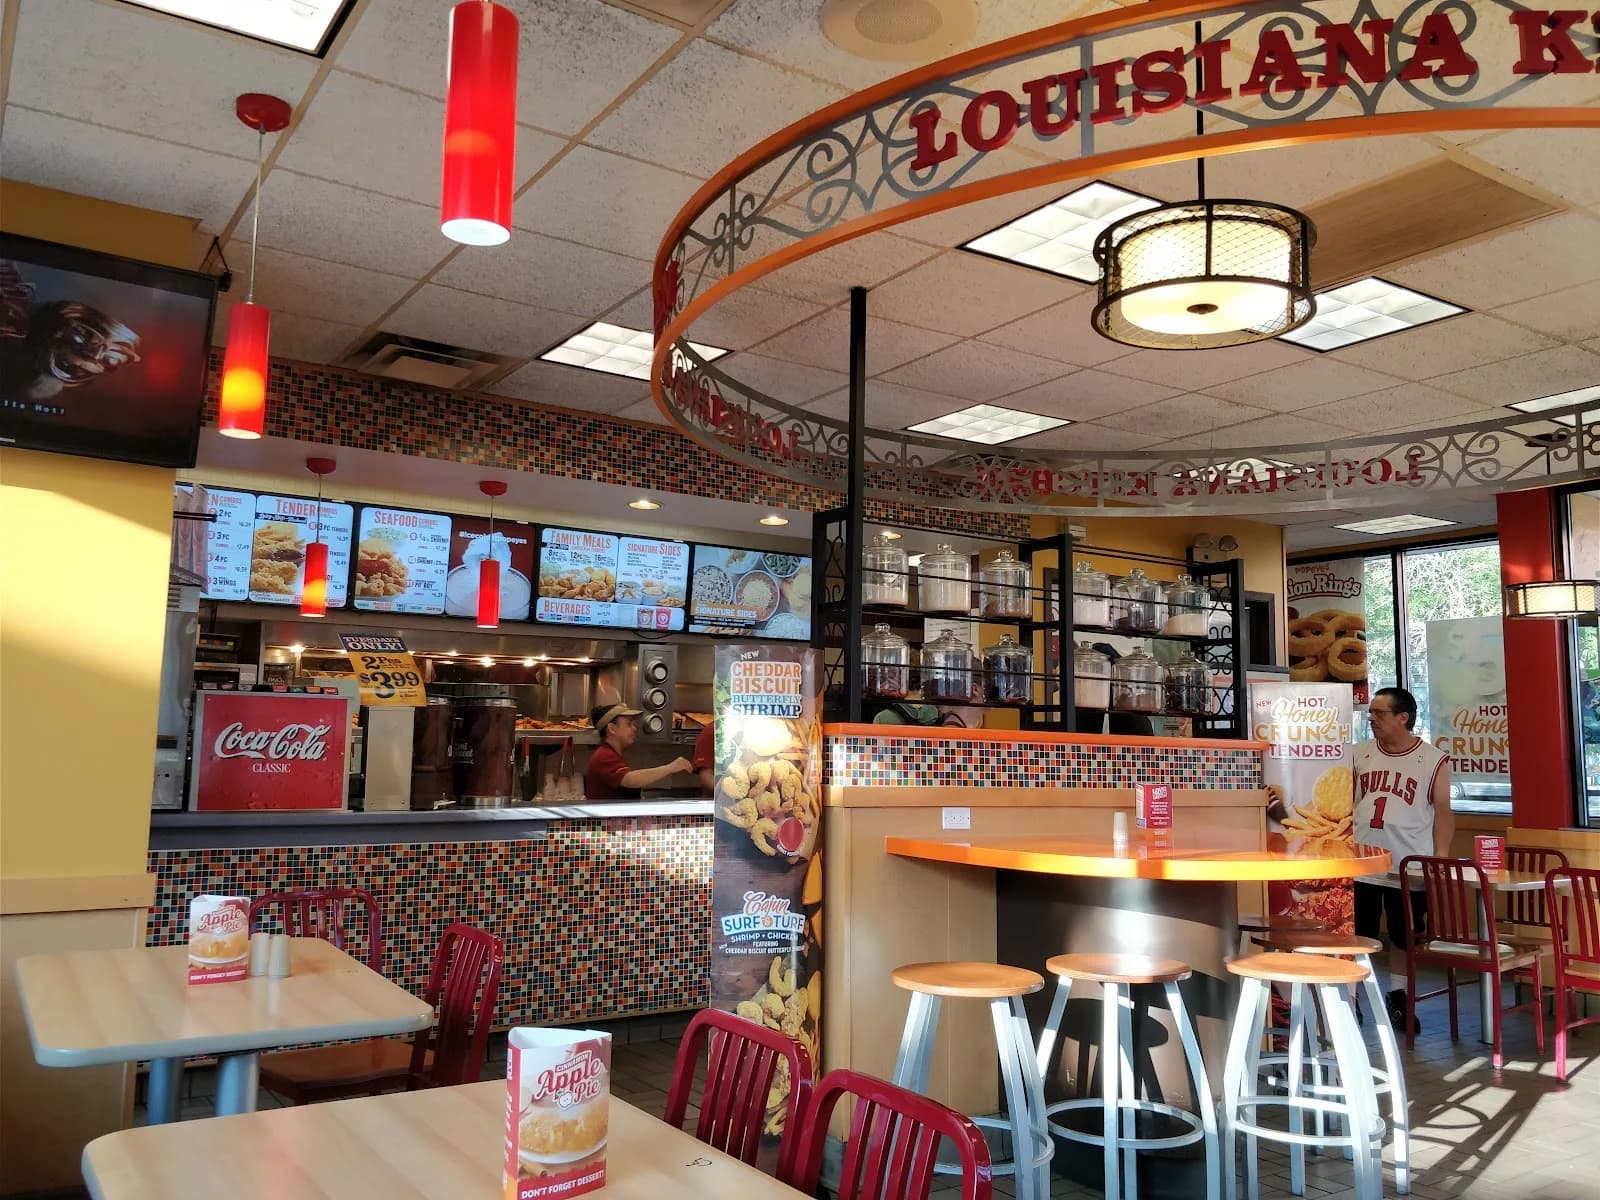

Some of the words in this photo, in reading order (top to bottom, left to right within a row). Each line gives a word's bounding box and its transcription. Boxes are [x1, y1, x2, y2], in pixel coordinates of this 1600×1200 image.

[910, 14, 1478, 171] LOUISIANA
[1509, 10, 1600, 75] K
[276, 500, 316, 517] TENDER
[374, 510, 418, 528] SEAFOOD
[551, 530, 582, 546] FAMILY
[582, 533, 613, 550] MEALS
[660, 543, 682, 557] SIDES
[1287, 578, 1313, 598] ion
[1314, 572, 1362, 598] Rings
[544, 600, 592, 616] BEVERAGES
[348, 642, 405, 651] ONLY!
[361, 656, 381, 670] 2
[741, 650, 760, 661] NEW
[732, 663, 801, 678] CHEDDAR
[732, 678, 801, 694] BISCUIT
[732, 694, 803, 704] BUTTERFLY
[1256, 700, 1273, 708] NEW
[1298, 697, 1325, 708] HOT
[732, 703, 802, 717] SHRIMP
[1270, 699, 1338, 735] Honey
[1453, 708, 1510, 736] Hone
[214, 722, 331, 760] Coca-Cola
[1435, 736, 1510, 756] CRUN
[1269, 743, 1343, 758] TENDERS
[252, 762, 292, 773] CLASSIC
[1450, 758, 1509, 773] TENDE
[1360, 770, 1418, 806] BULLS
[1369, 796, 1387, 830] 1
[743, 890, 791, 916] Cajun
[200, 906, 241, 932] Apple
[724, 916, 760, 932] SURF
[773, 914, 806, 929] TURF
[731, 933, 760, 944] SHRIMP
[534, 1057, 601, 1101] Apple
[574, 1077, 600, 1103] Pie
[521, 1183, 548, 1200] DON'T
[548, 1179, 577, 1194] FORGET
